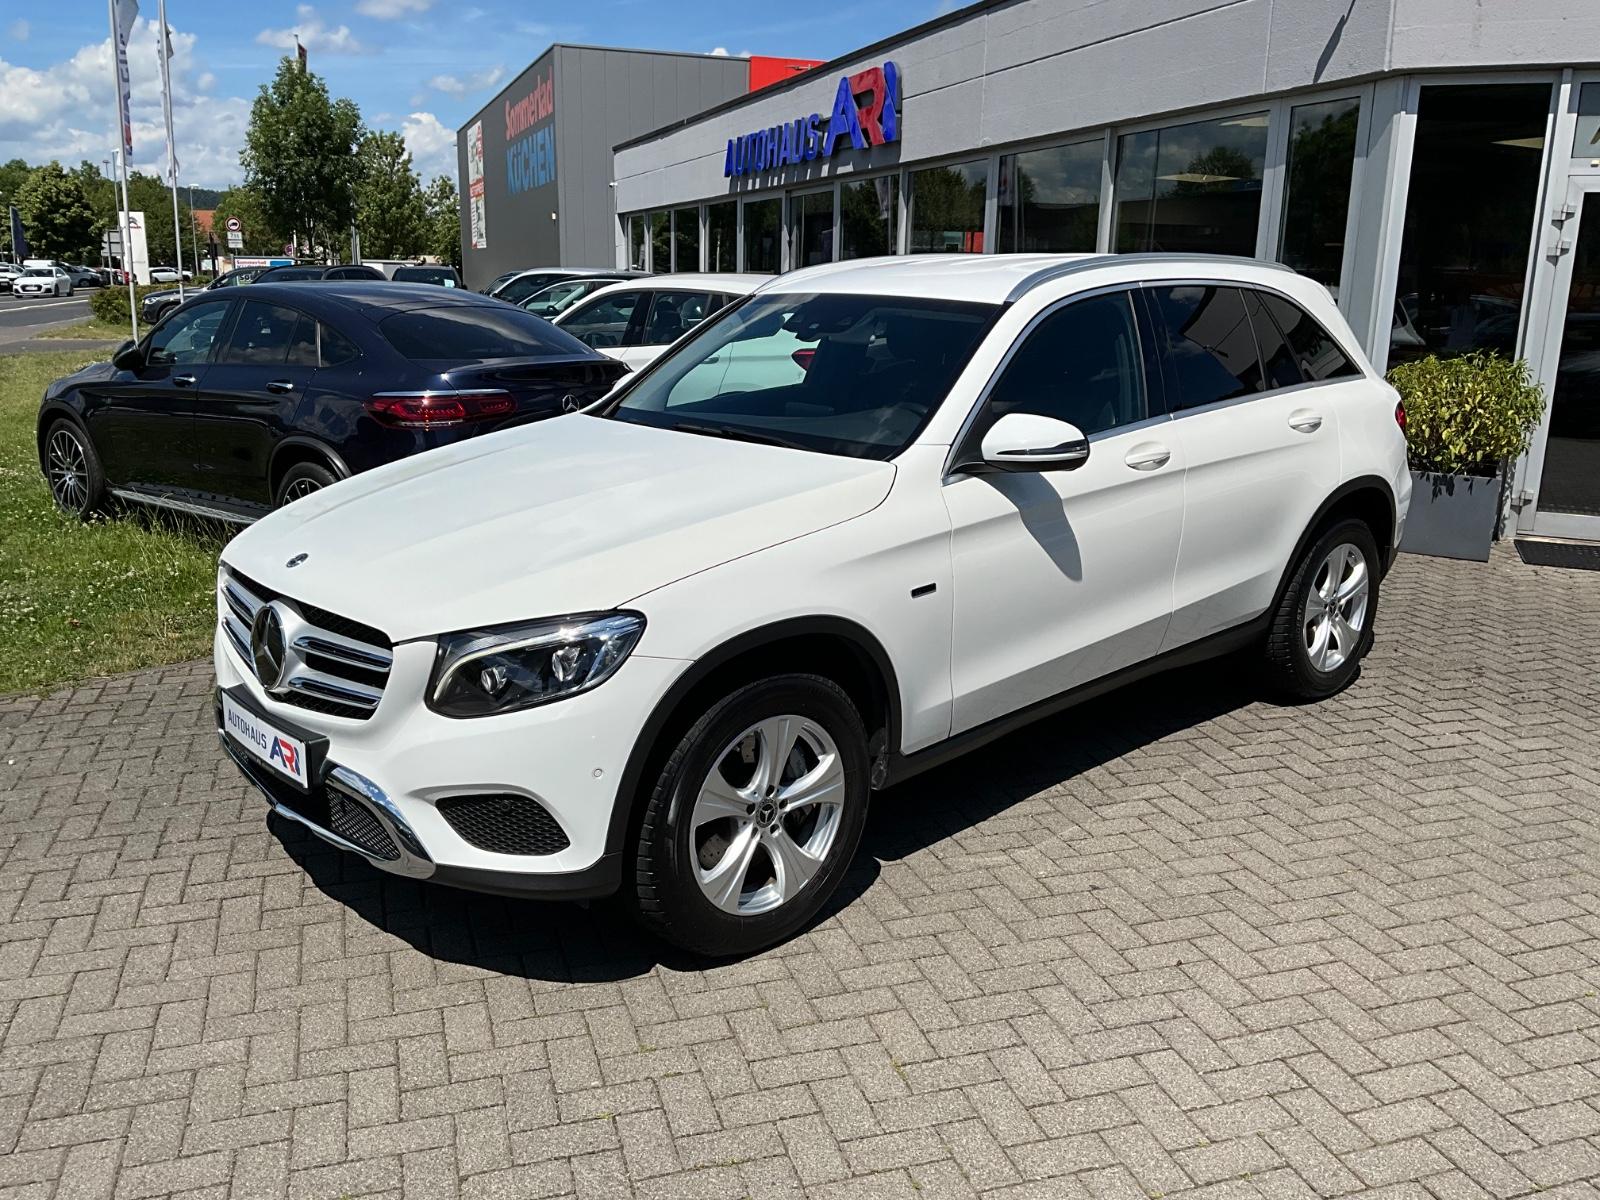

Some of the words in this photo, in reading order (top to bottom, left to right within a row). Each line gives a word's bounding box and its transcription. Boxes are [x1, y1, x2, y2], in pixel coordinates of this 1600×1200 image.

[505, 65, 553, 141] Sommerlad
[724, 113, 821, 177] AUTOHAUS
[823, 61, 897, 157] ARI
[228, 709, 267, 750] AUTOHAUS
[269, 735, 301, 777] ARI
